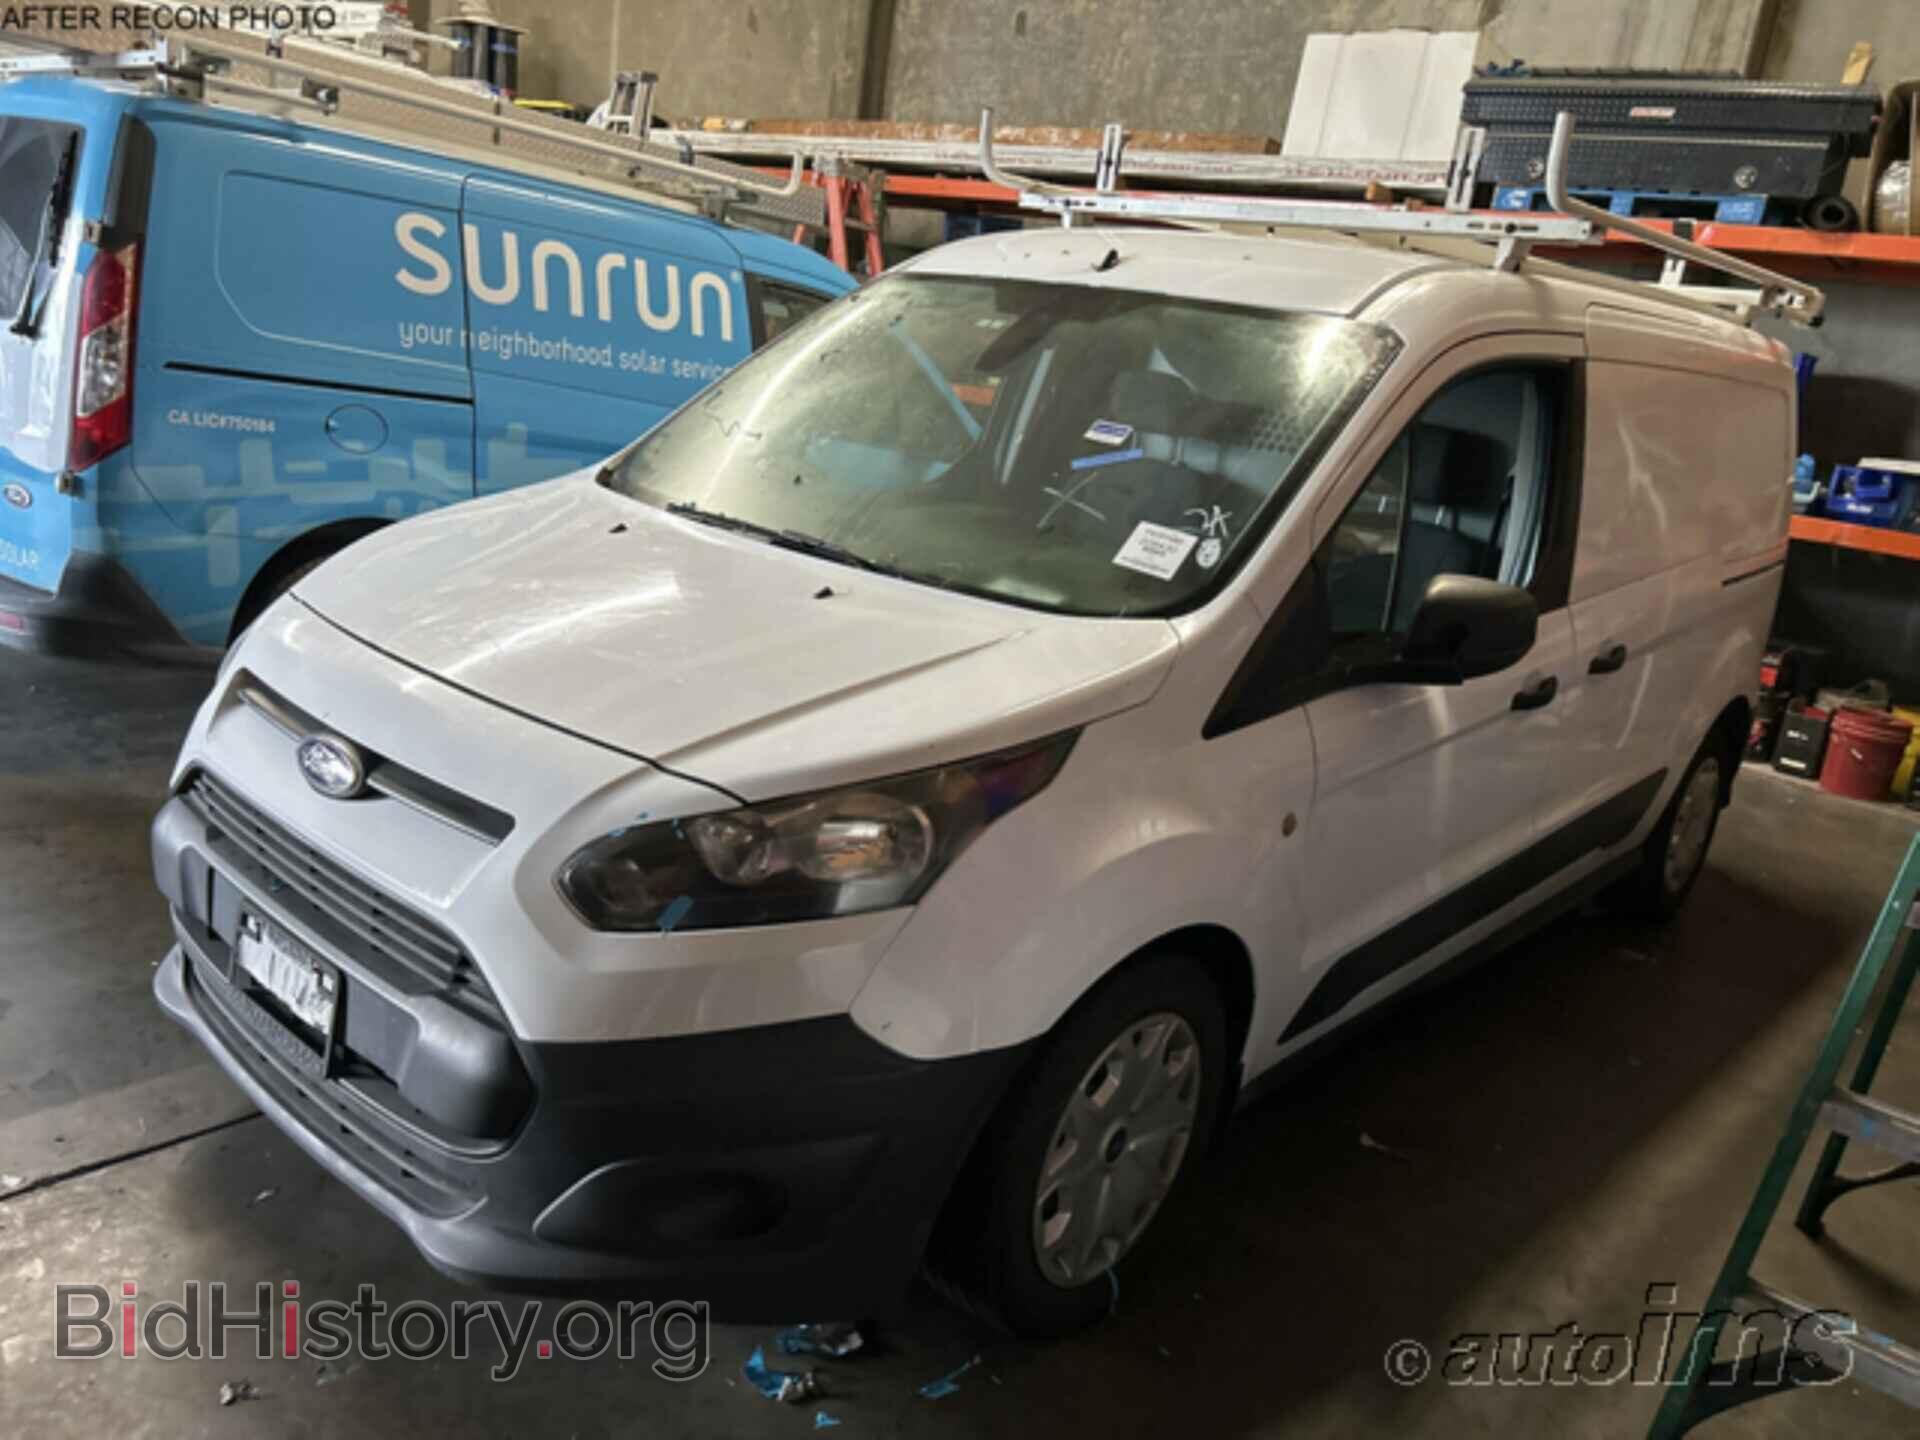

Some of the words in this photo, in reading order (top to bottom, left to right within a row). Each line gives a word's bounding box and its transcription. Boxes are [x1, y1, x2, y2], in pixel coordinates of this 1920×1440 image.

[398, 320, 453, 349] your
[460, 326, 613, 368] neighborhood
[618, 348, 666, 375] solar
[167, 408, 190, 426] CA
